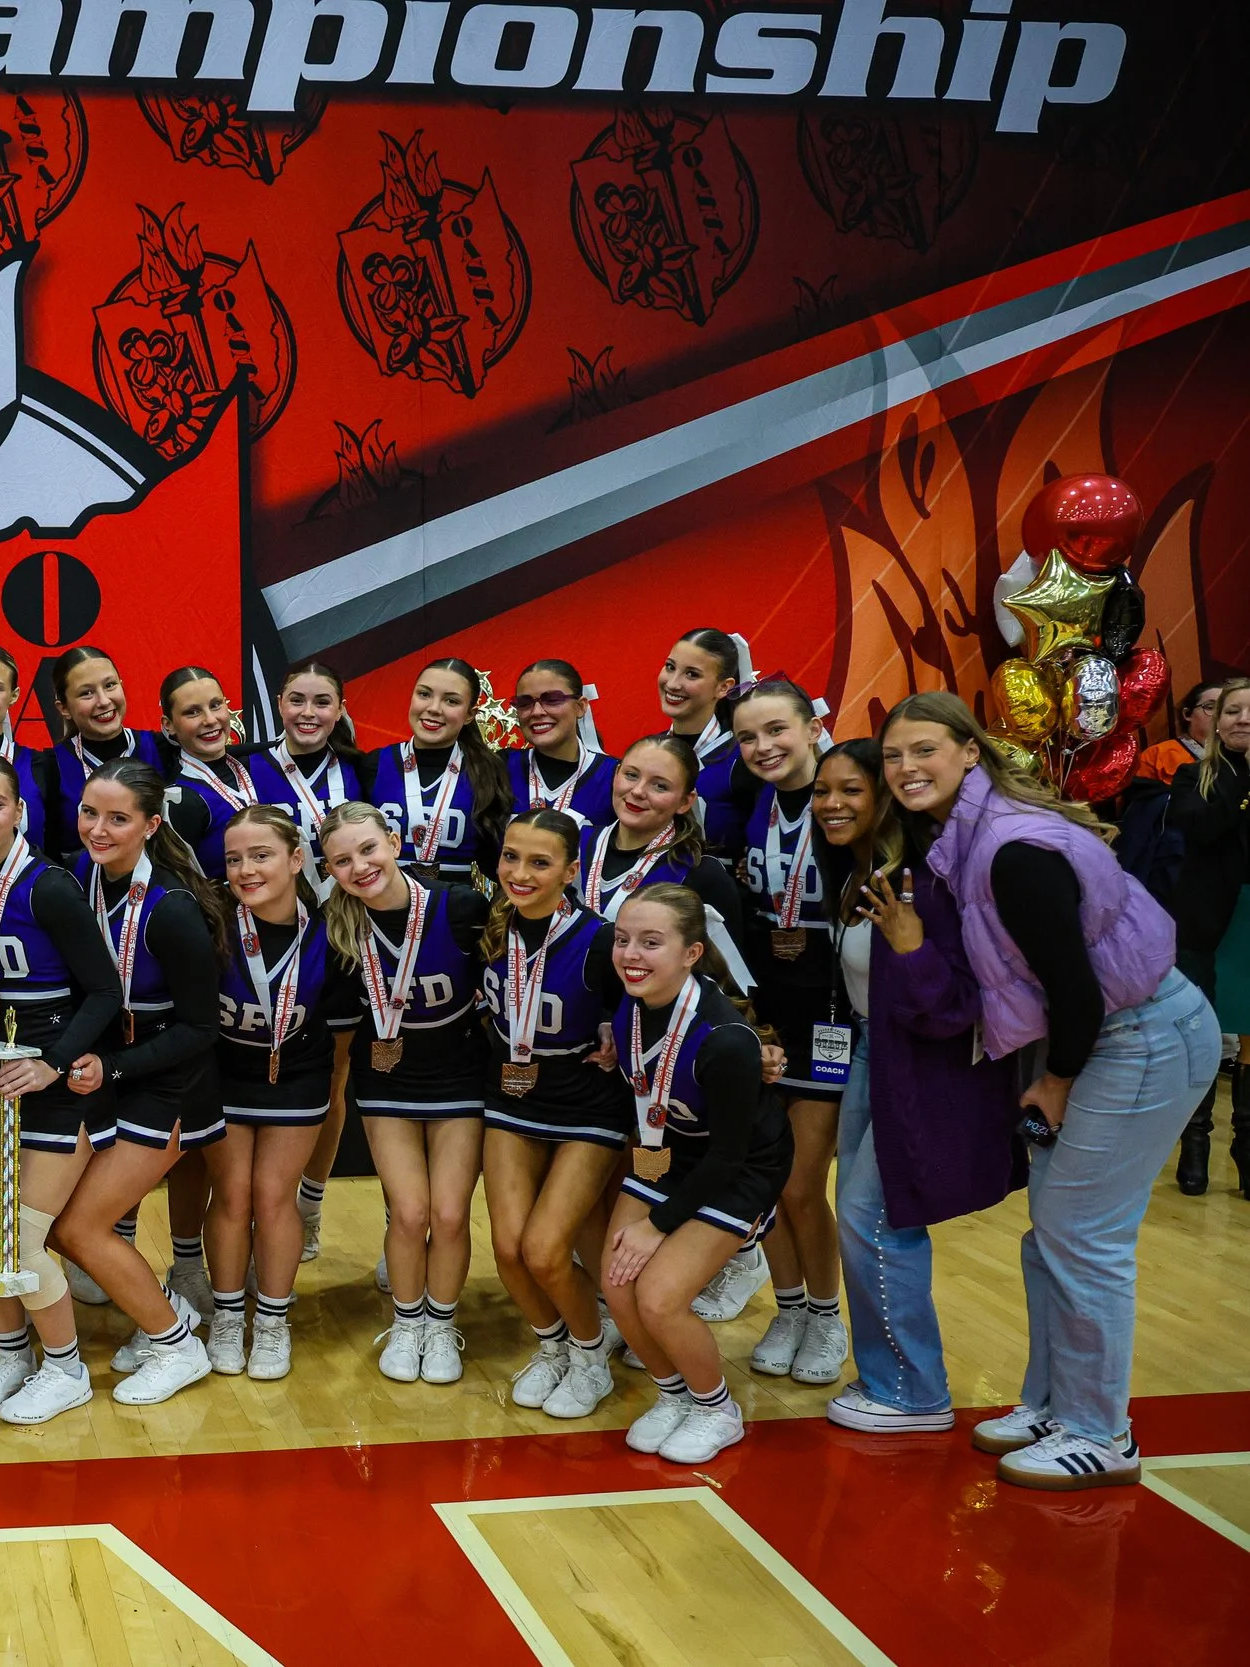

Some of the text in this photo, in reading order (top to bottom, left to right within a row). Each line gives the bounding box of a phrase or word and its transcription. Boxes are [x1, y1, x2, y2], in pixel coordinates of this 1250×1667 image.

[451, 216, 503, 331] OASSA
[428, 818, 445, 861] HAMPION
[117, 919, 130, 977] CHAMPION
[126, 949, 137, 978] STATE
[362, 955, 379, 1011] CHAMPION
[483, 966, 564, 1035] SD
[508, 948, 516, 1007] CHAMPION
[653, 1031, 674, 1089] 2026 STATE
[662, 1034, 684, 1093] CHAMPION
[815, 1065, 845, 1075] COACH
